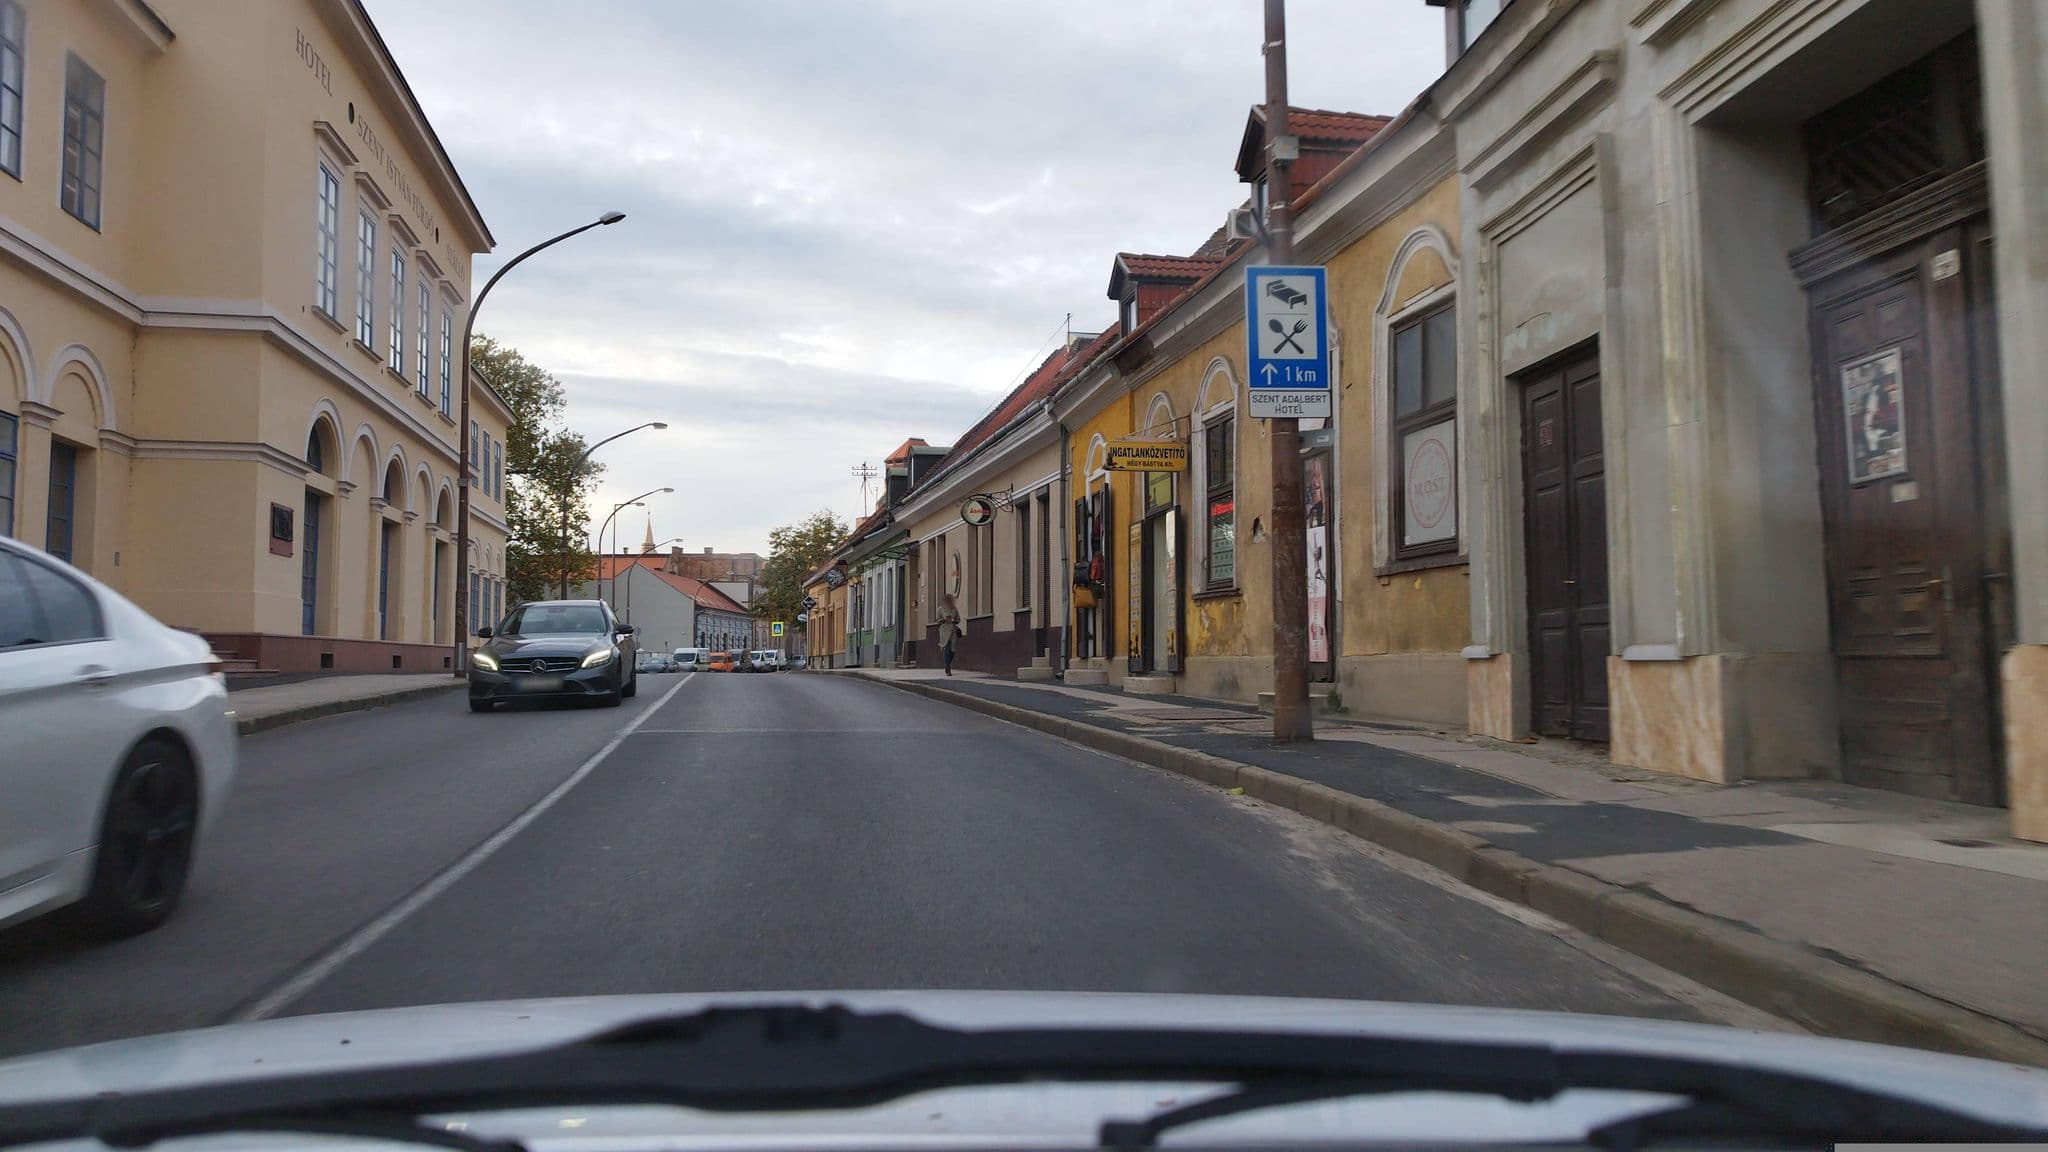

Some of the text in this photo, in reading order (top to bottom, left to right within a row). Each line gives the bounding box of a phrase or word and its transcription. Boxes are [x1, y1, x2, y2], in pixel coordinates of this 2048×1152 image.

[296, 27, 333, 97] HOTEL
[357, 114, 384, 166] SZENT
[386, 154, 412, 206] ISTVÁN
[1285, 366, 1316, 382] 1 km
[1252, 394, 1328, 403] SZENT ADALBERT
[1275, 405, 1304, 414] HOTEL
